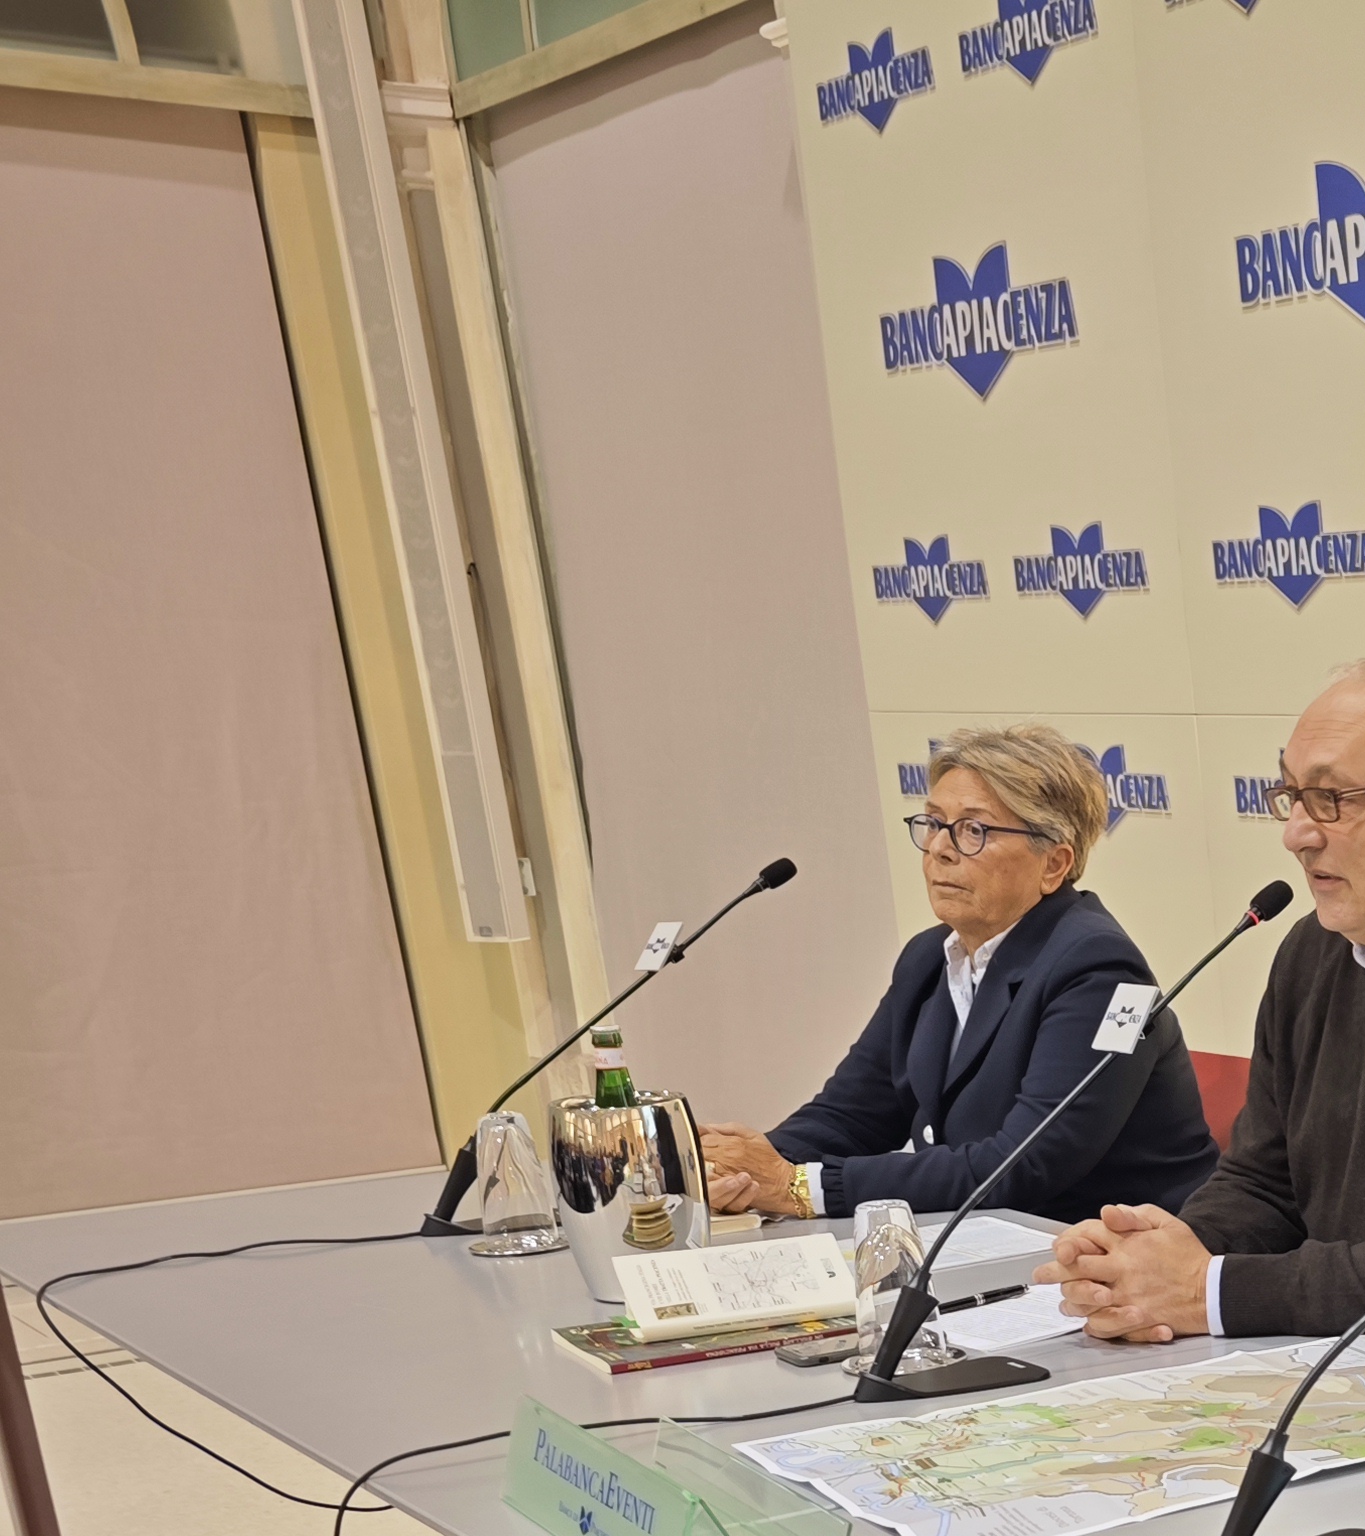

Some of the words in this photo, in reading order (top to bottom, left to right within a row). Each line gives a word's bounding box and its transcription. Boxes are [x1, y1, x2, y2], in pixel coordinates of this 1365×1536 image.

[817, 46, 933, 122] BANCAPIACENZA
[881, 279, 1078, 373] BANCAPIACENZA
[873, 560, 988, 600] BANCAPIACENZA
[1014, 549, 1147, 593] BANCAPIACENZA
